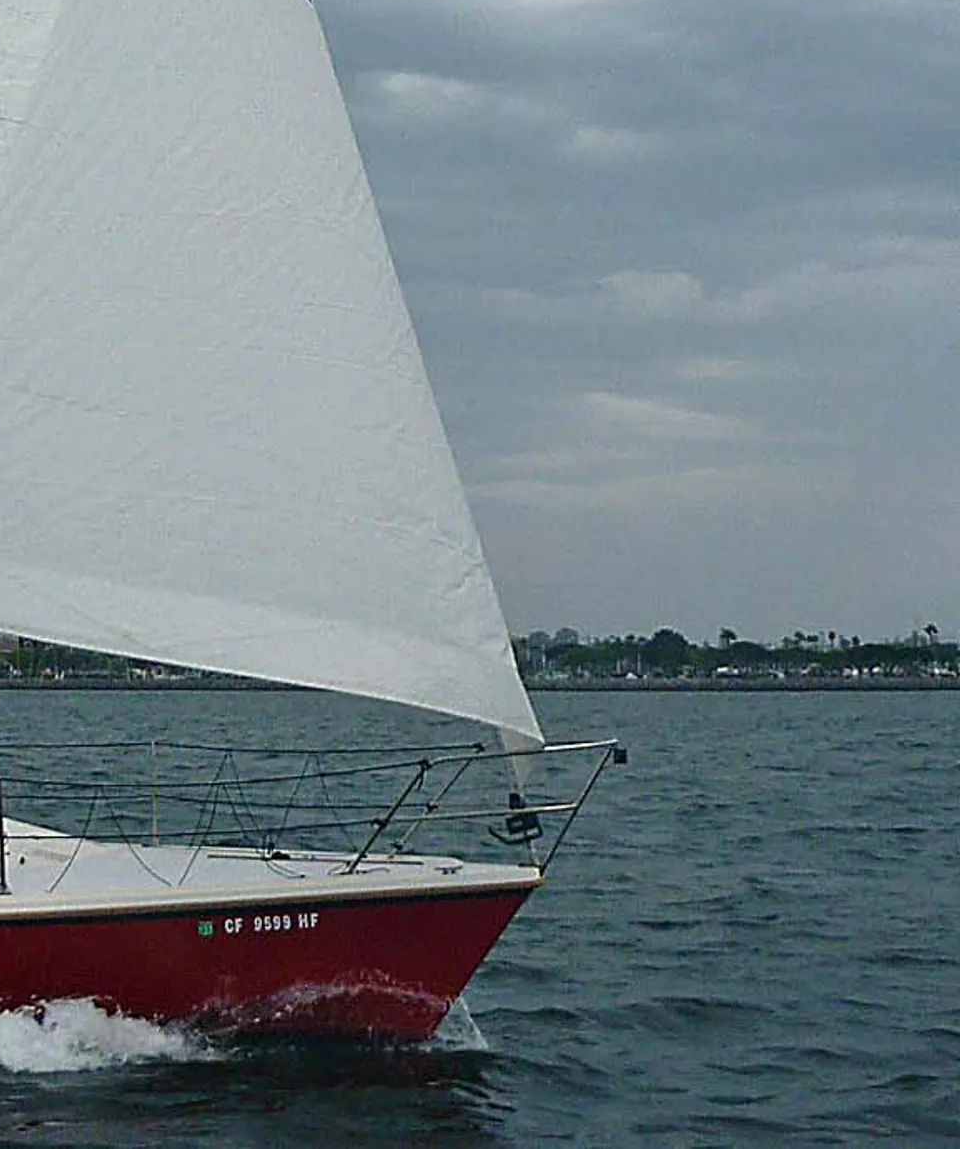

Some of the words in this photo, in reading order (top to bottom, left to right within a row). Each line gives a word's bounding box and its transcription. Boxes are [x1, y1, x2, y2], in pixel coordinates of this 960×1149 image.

[224, 917, 243, 934] CF
[253, 914, 292, 932] 9599
[298, 912, 319, 929] HF
